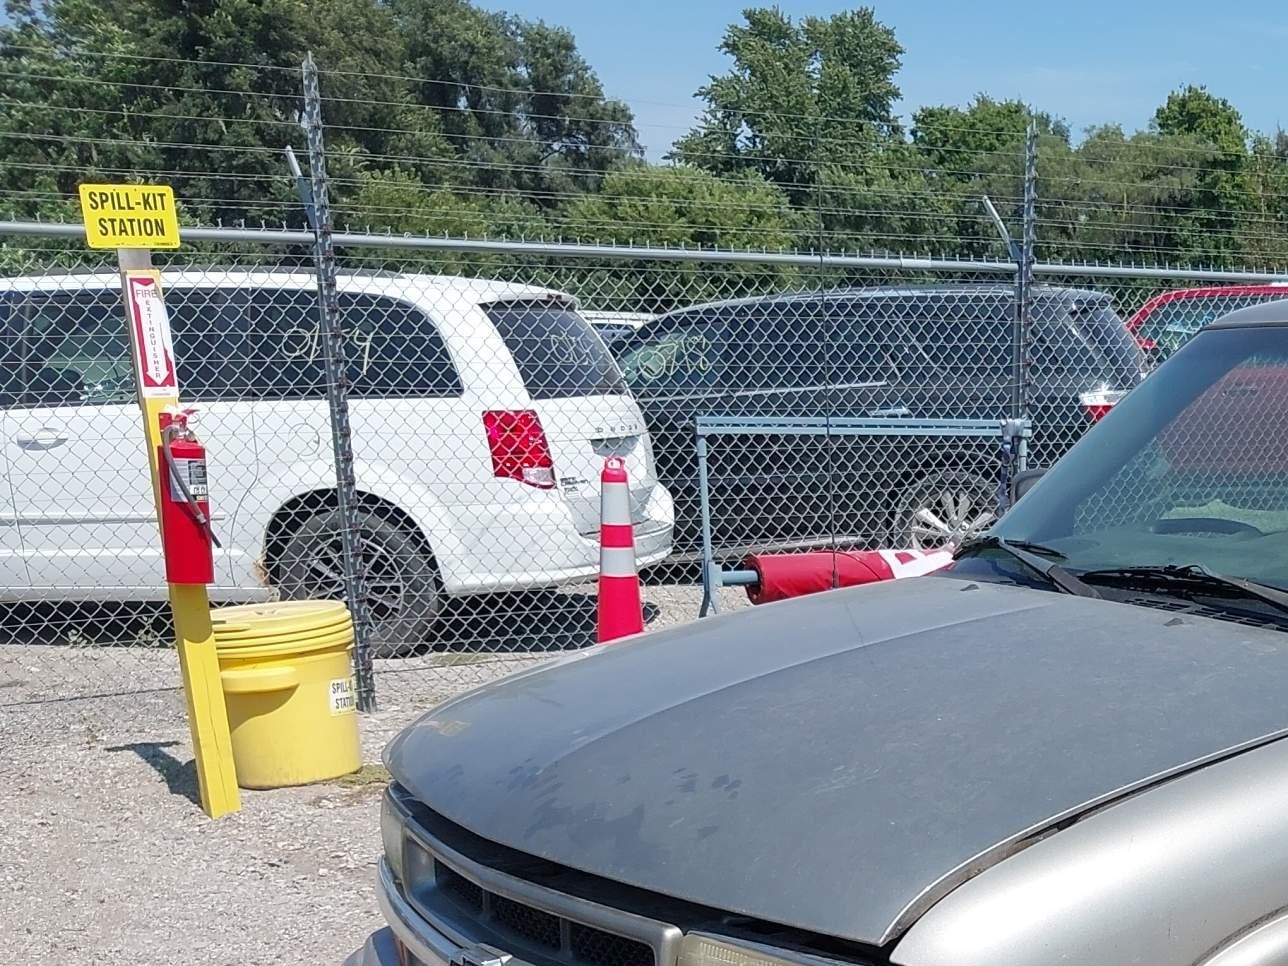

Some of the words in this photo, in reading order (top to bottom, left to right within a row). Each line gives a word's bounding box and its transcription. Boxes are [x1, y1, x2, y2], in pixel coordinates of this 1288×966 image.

[88, 191, 166, 211] SPILL-KIT
[98, 217, 166, 237] STATION
[136, 289, 158, 298] FIRE
[145, 300, 162, 378] EXTINGUISHER
